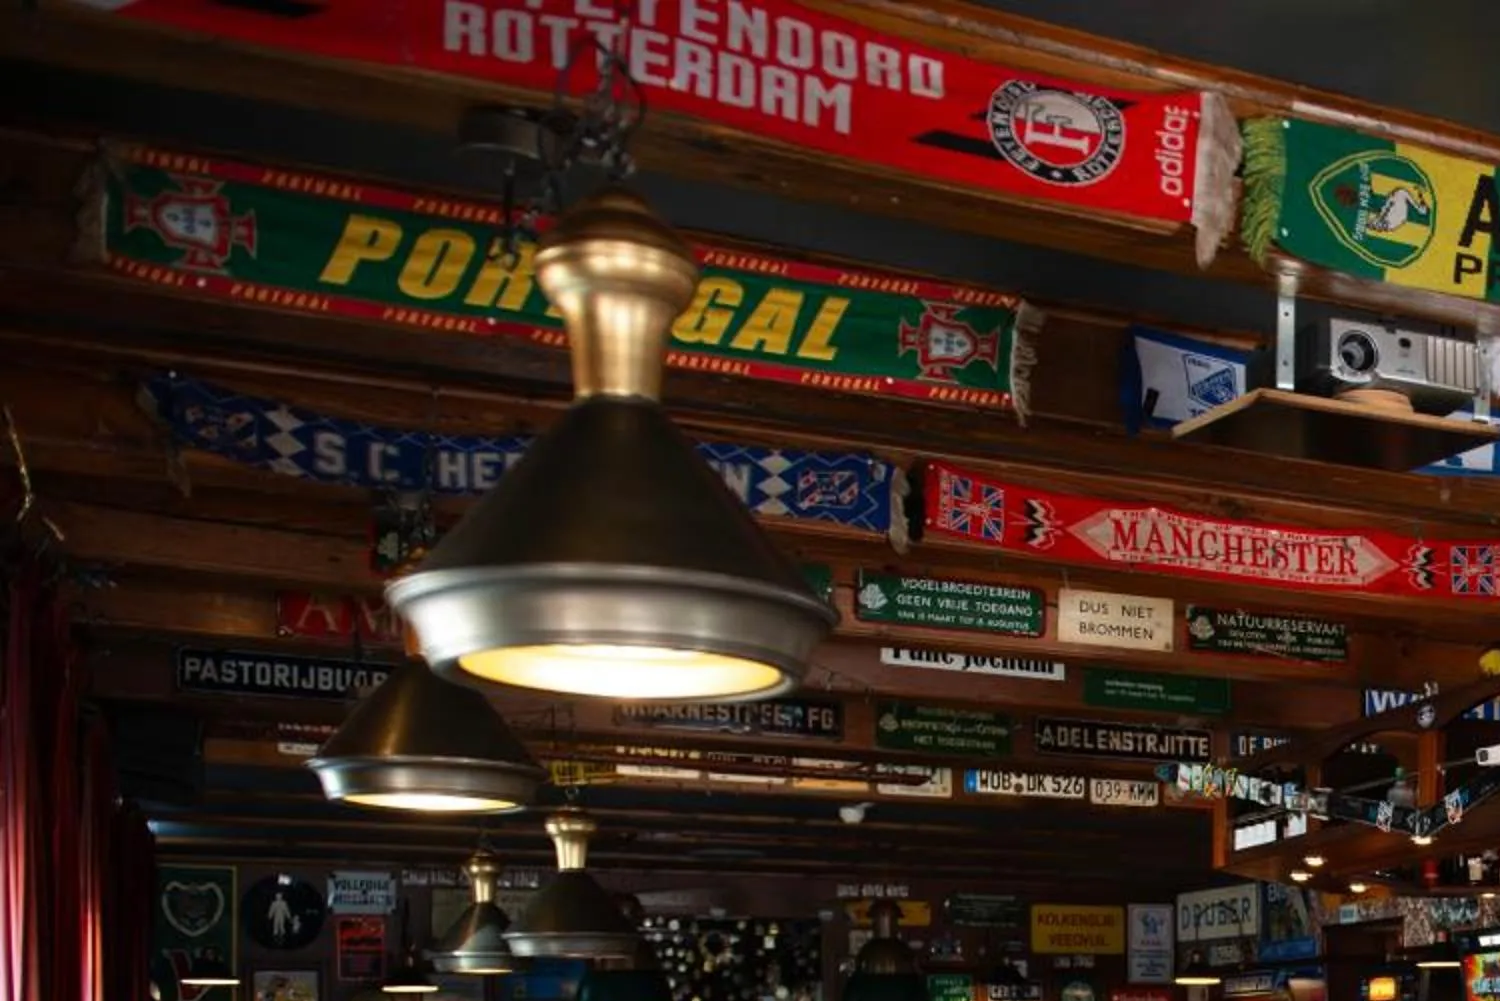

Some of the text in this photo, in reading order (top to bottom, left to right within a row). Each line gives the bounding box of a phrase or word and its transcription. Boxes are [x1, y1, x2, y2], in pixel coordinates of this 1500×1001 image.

[443, 2, 852, 134] ROTTERDAM
[1154, 105, 1189, 196] adidas
[318, 213, 851, 361] PORGAL
[1111, 518, 1358, 576] MANCHESTER
[895, 593, 1034, 617] GEEN VRIJE TOEGANG
[1079, 600, 1154, 620] DUS NIET
[1079, 621, 1155, 641] BROMMEN
